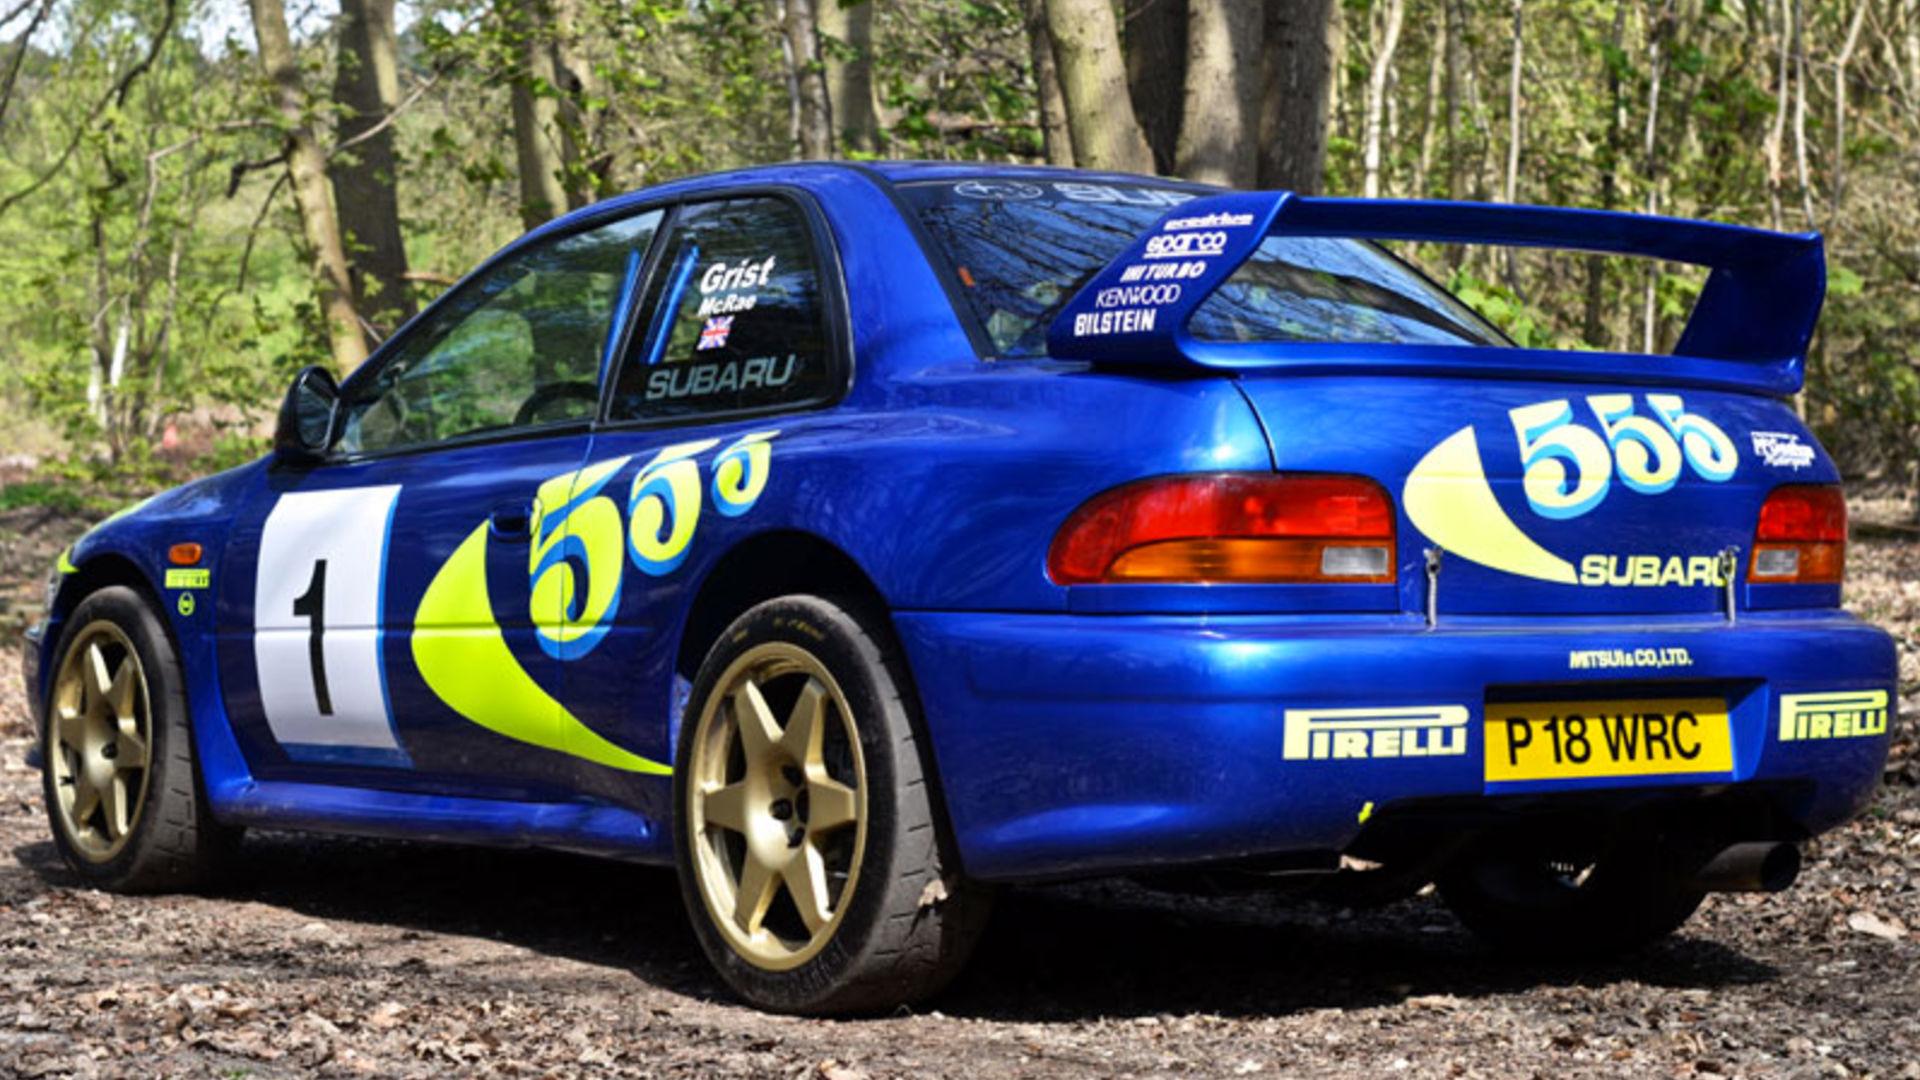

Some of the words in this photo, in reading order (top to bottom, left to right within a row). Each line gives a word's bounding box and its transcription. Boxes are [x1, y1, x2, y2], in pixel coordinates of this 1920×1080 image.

[1142, 230, 1227, 259] sparco
[700, 255, 776, 294] Grist
[1144, 260, 1207, 280] TURBO
[697, 294, 757, 317] McRae
[1095, 283, 1181, 308] KENWOOD
[1073, 308, 1157, 336] BILSTEIN
[645, 354, 797, 400] SUBARU
[1508, 393, 1739, 520] 555
[529, 429, 782, 661] 555
[293, 559, 334, 716] 1
[1283, 705, 1469, 760] PIRELLI
[1600, 710, 1702, 763] WRC
[1778, 689, 1888, 742] PIRELLI
